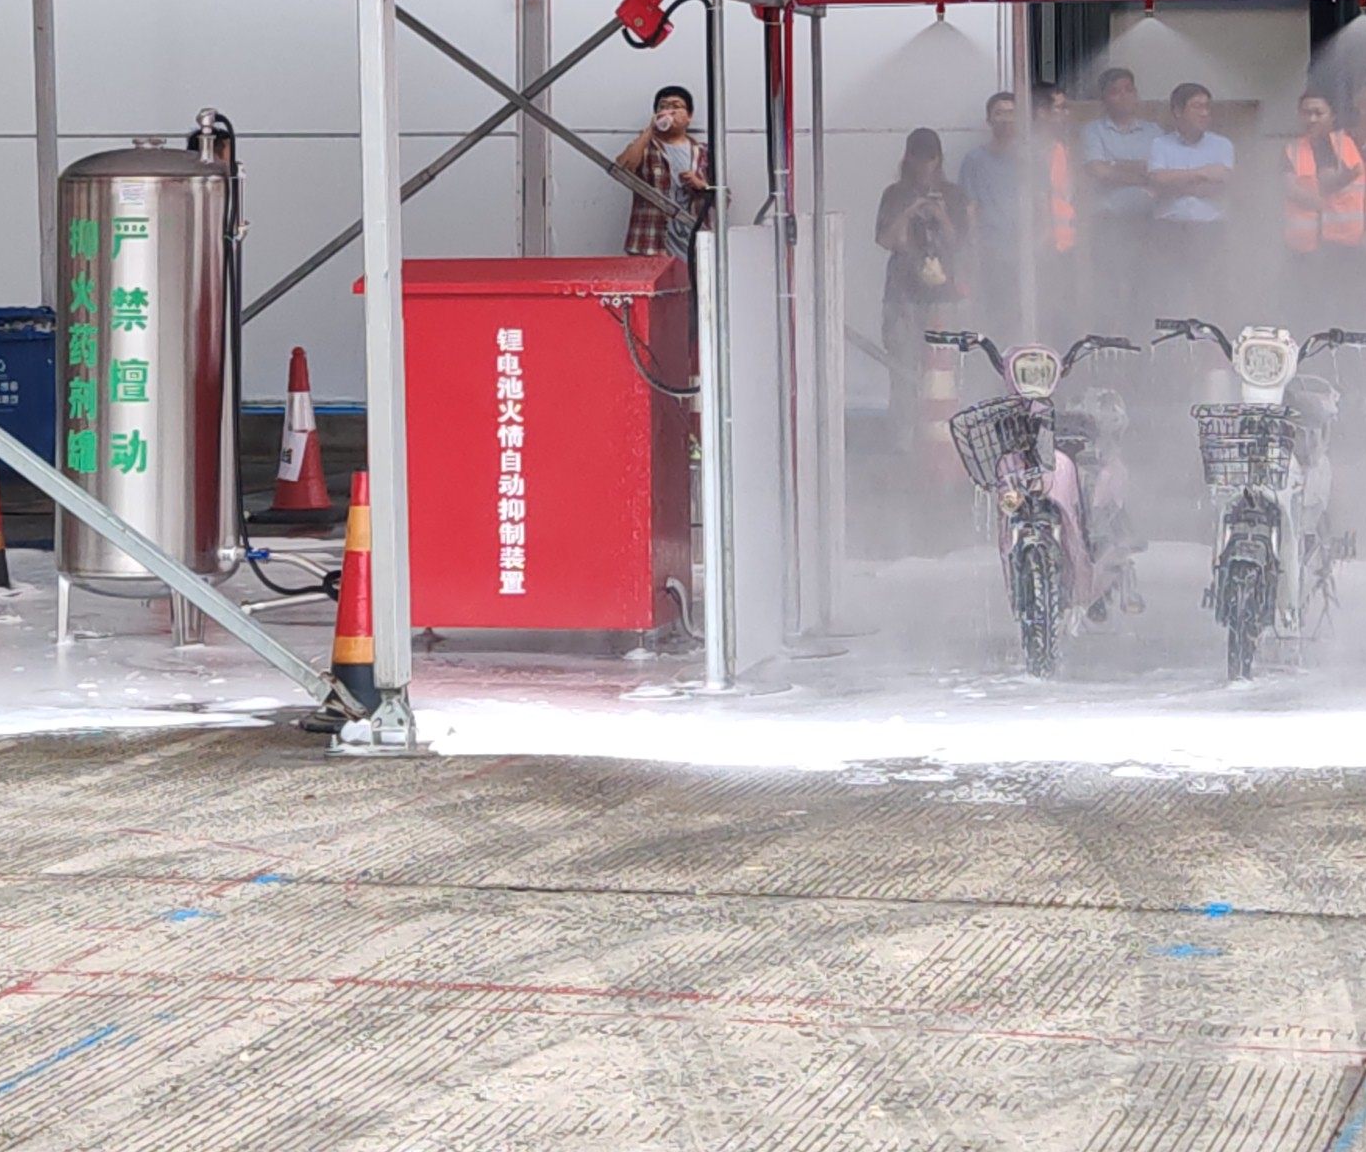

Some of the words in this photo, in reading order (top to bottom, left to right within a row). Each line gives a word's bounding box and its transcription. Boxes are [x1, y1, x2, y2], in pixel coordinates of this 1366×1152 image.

[67, 218, 100, 475] 抑火药剂罐
[496, 327, 526, 595] 锂电池火情自动抑制装置
